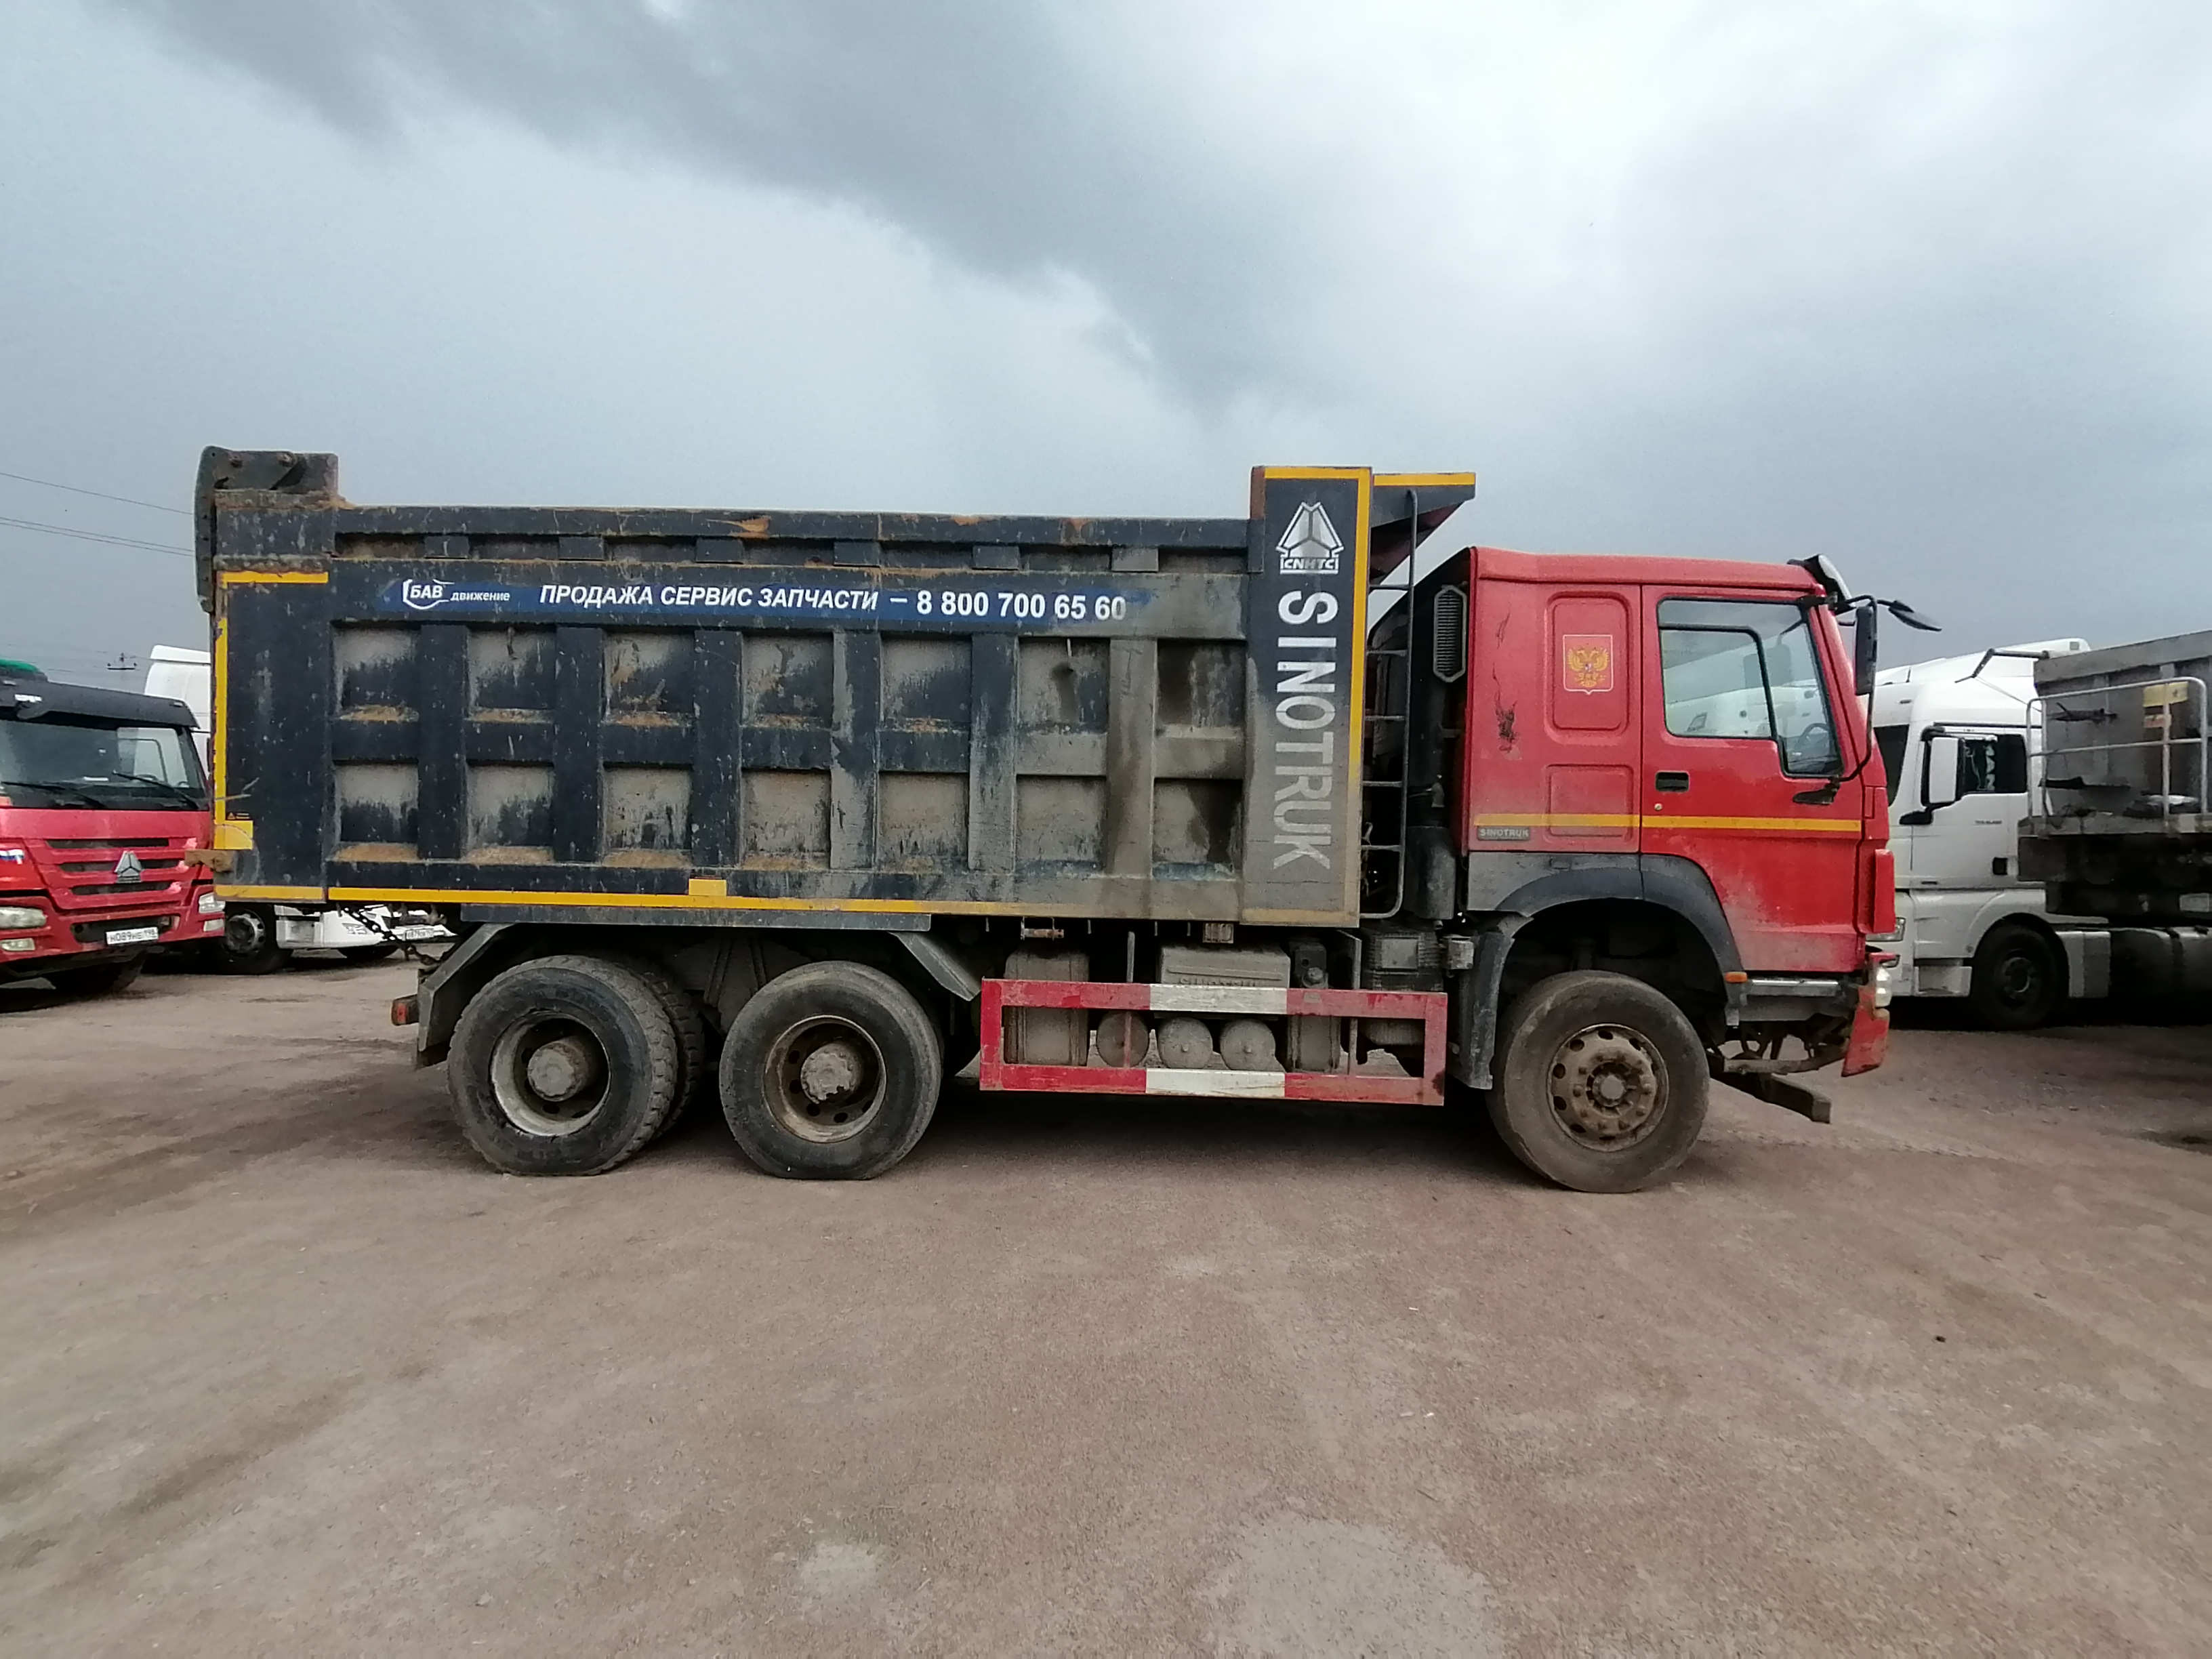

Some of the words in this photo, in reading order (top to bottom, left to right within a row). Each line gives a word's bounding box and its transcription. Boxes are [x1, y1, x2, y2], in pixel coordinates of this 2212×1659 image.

[1284, 558, 1335, 569] CNHTC
[410, 584, 443, 598] БАВ
[450, 592, 510, 602] движение
[539, 584, 653, 609] ПРОДАЖА
[660, 586, 753, 607] СЕРВИС
[757, 588, 879, 610] ЗАПЧАСТИ
[916, 590, 933, 615] 8
[941, 591, 989, 617] 800
[998, 592, 1046, 619] 700
[1054, 594, 1086, 620] 65
[1094, 596, 1128, 621] 60
[1273, 590, 1339, 870] SINOTRUK
[1480, 828, 1530, 837] SINOTRUK
